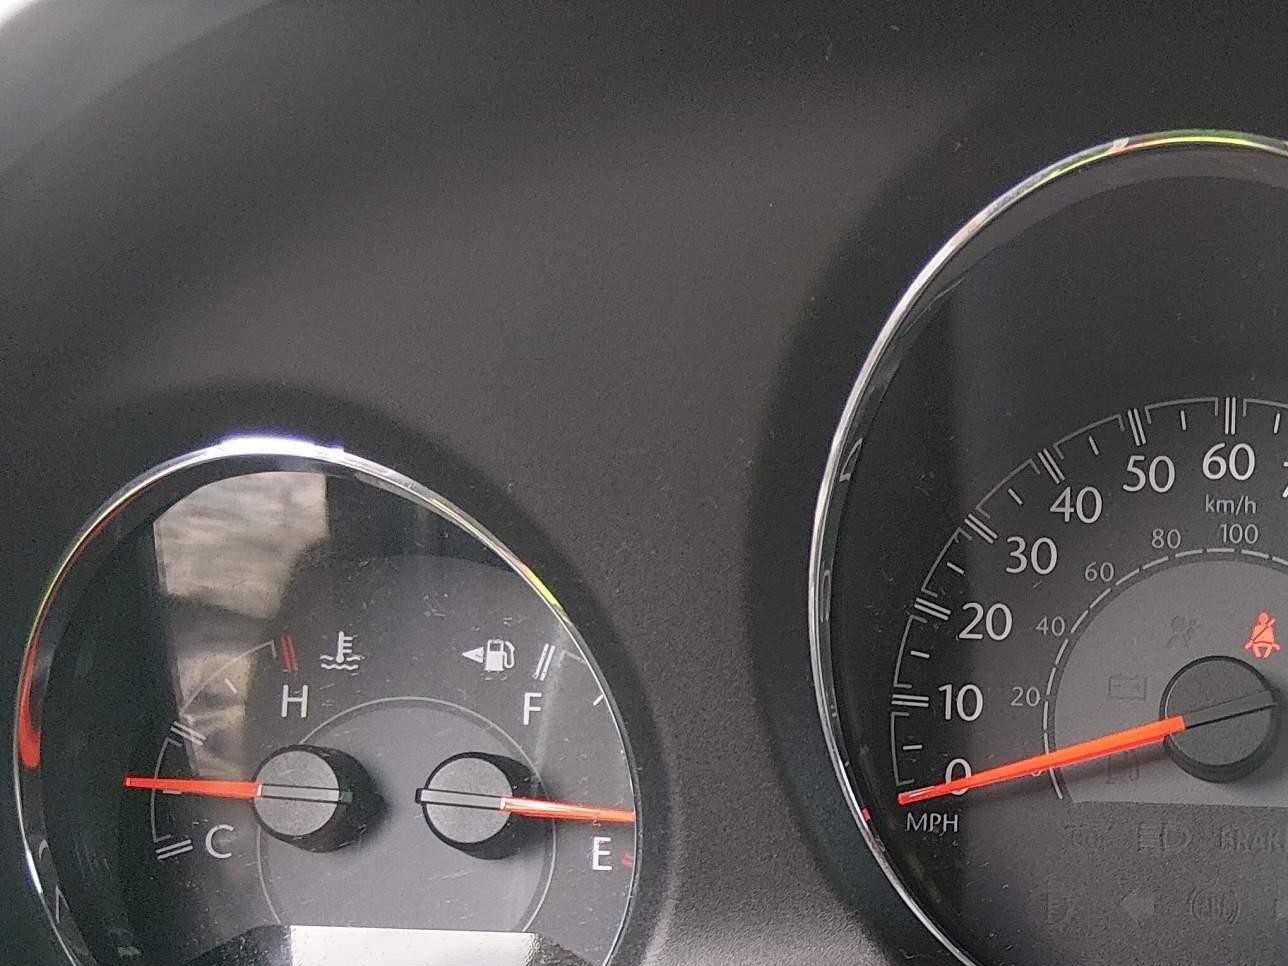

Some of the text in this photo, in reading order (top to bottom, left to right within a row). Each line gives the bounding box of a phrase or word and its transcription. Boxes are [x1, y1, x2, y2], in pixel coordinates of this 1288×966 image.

[1123, 456, 1175, 492] 50
[1203, 443, 1254, 480] 60
[1050, 487, 1102, 523] 40
[1206, 494, 1256, 515] km/h
[1152, 529, 1181, 548] 80
[1221, 524, 1258, 544] 100
[1007, 537, 1057, 574] 30
[1085, 562, 1114, 582] 60
[959, 603, 1012, 640] 20
[1036, 616, 1065, 636] 40
[282, 685, 308, 717] H
[524, 693, 541, 725] F
[939, 685, 983, 721] 10
[1011, 687, 1040, 706] 20
[946, 759, 971, 795] 0
[907, 813, 958, 832] MPH
[206, 825, 237, 858] C
[592, 837, 612, 870] E
